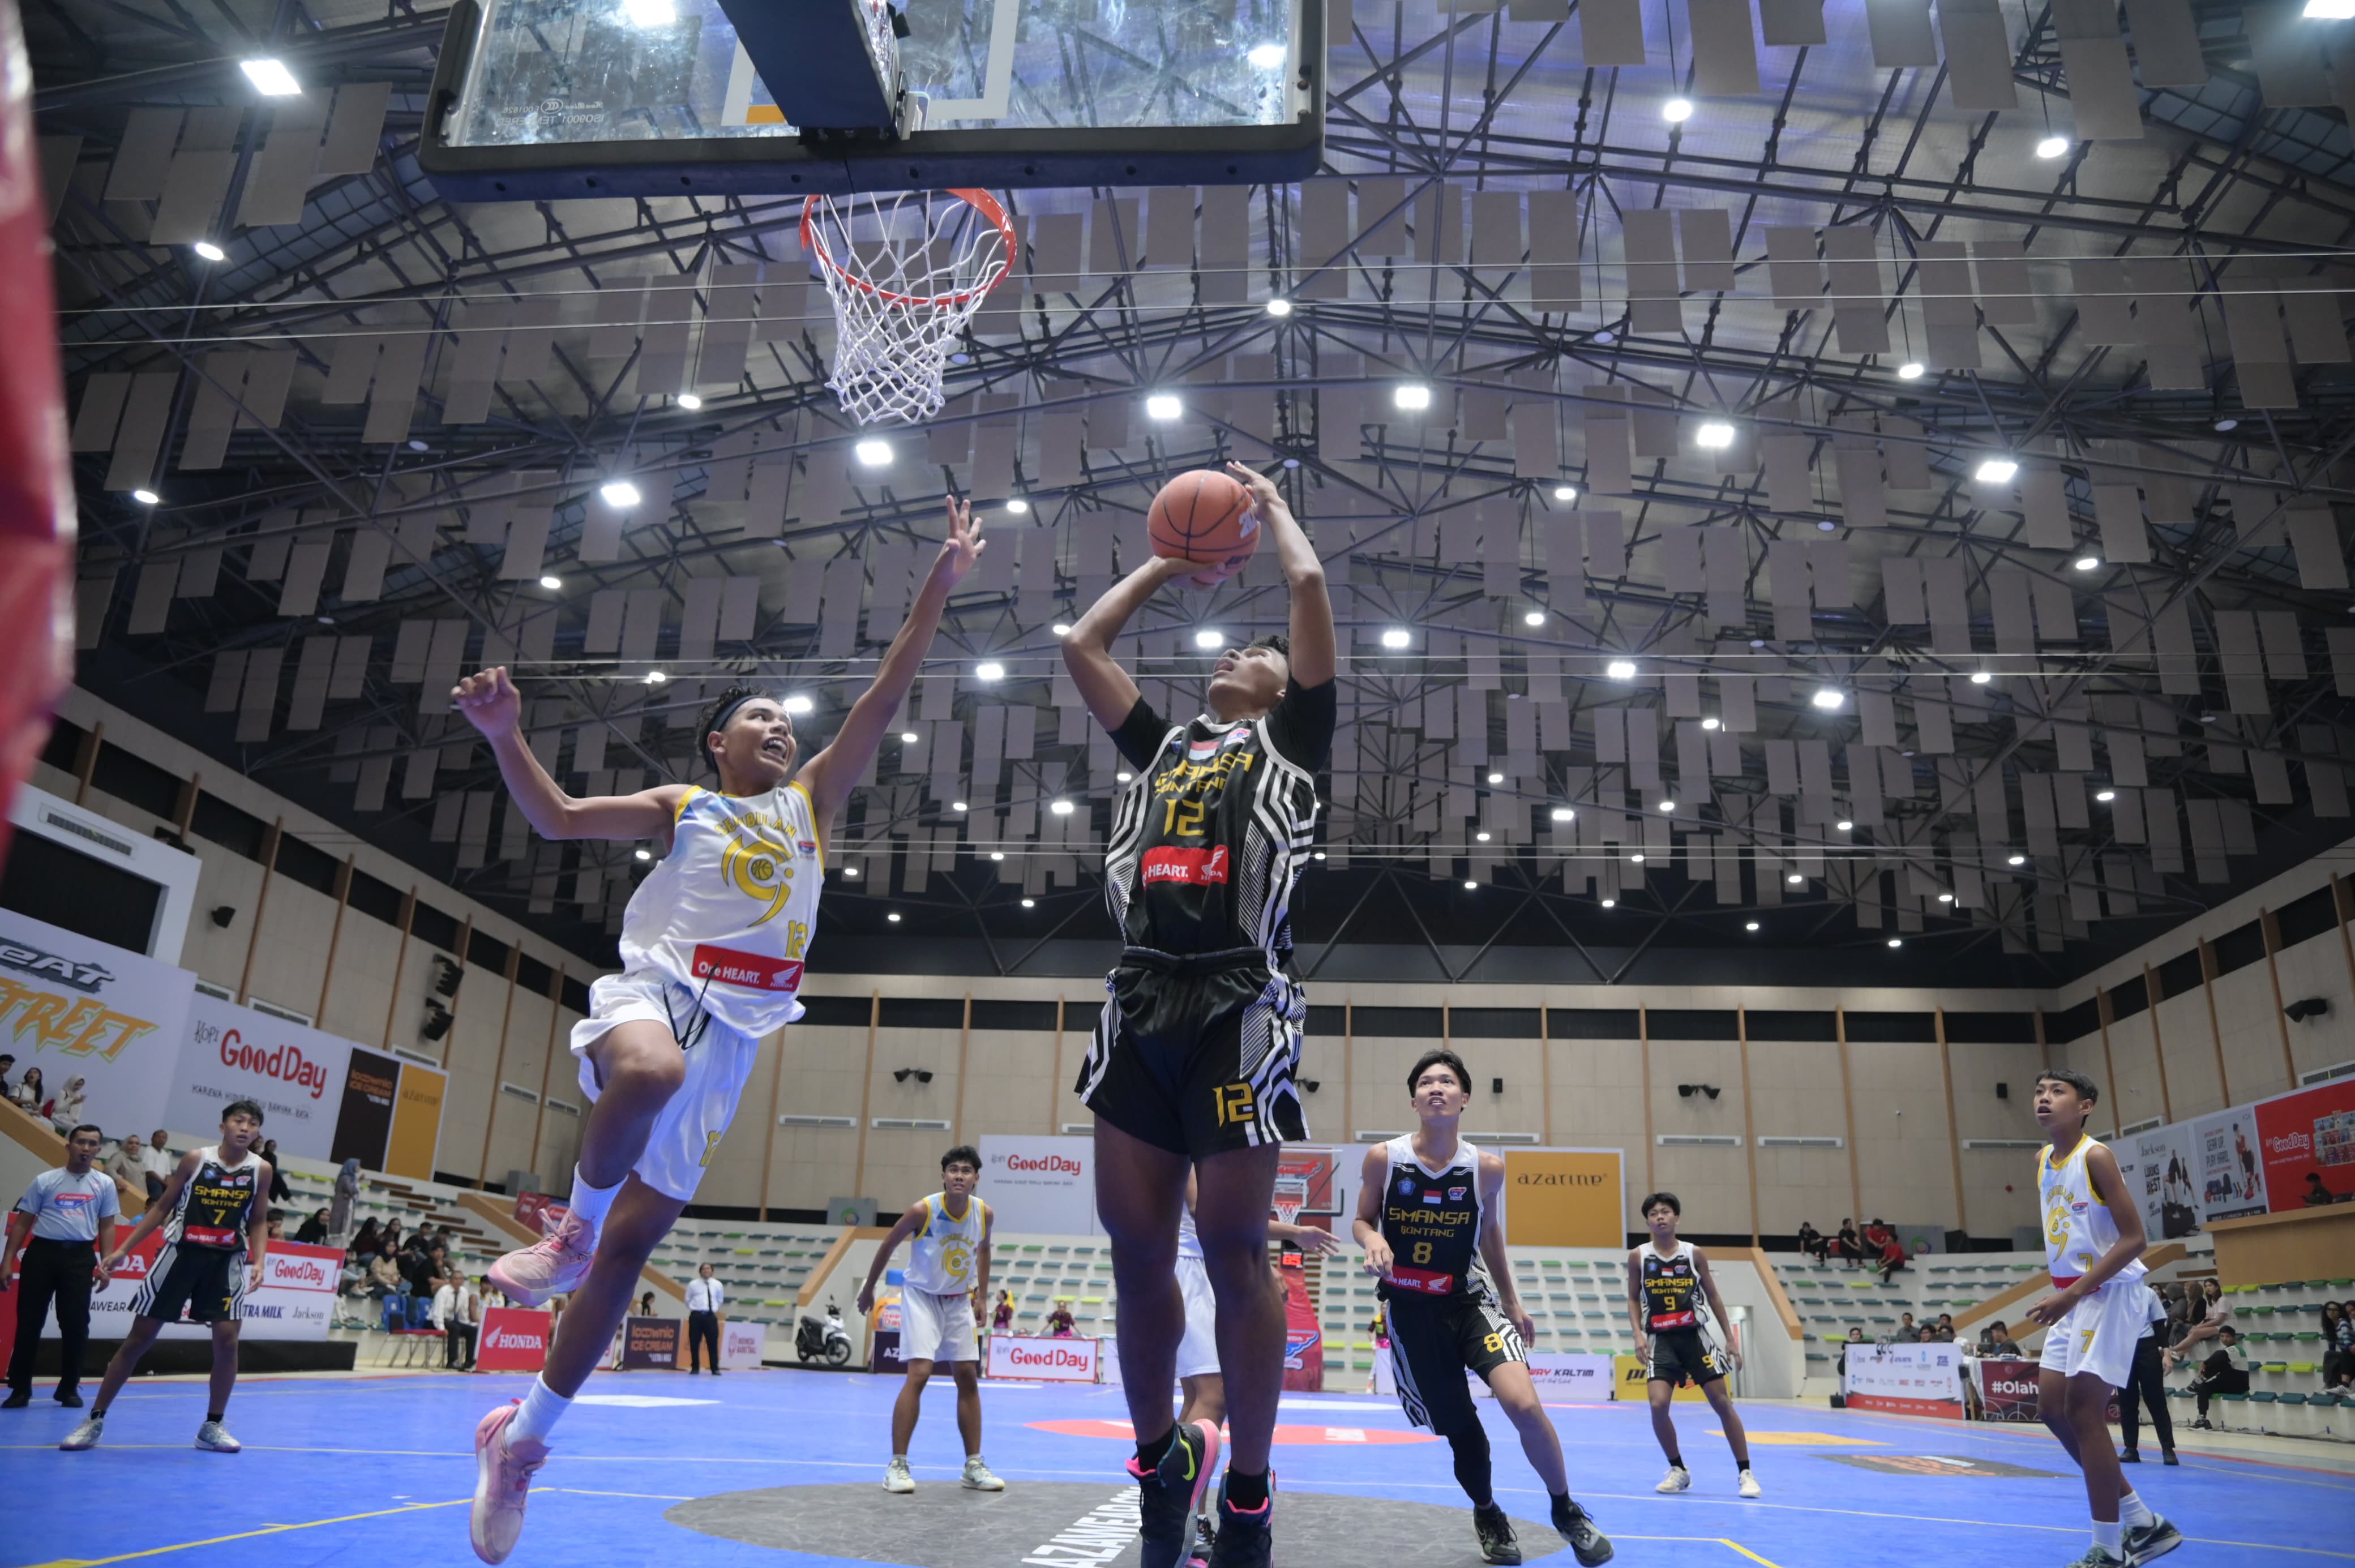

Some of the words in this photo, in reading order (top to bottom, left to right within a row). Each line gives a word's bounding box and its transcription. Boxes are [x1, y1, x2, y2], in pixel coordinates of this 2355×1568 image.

[1164, 799, 1204, 836] 12
[1148, 863, 1189, 878] HEART.
[785, 920, 808, 959] 12
[722, 966, 761, 985] HEART.
[0, 976, 161, 1063] TREET
[1212, 1082, 1254, 1128] 12
[195, 1185, 251, 1199] SMANSA
[201, 1198, 242, 1208] BONTANG
[214, 1209, 226, 1224] 7
[1389, 1207, 1471, 1225] SMANSA
[1401, 1225, 1455, 1238] BONTANG
[1412, 1241, 1433, 1264] 8
[2078, 1253, 2093, 1273] 7
[1645, 1278, 1694, 1288] SMANSA
[222, 1297, 232, 1312] 7
[1664, 1296, 1676, 1311] 9
[262, 1305, 284, 1319] MILK
[292, 1306, 325, 1319] Jackson
[498, 1334, 543, 1349] HONDA
[630, 1340, 644, 1351] ICE
[645, 1340, 674, 1352] CREAM
[1484, 1333, 1504, 1353] 8
[2082, 1330, 2095, 1353] 7
[1702, 1355, 1715, 1368] 9
[1992, 1381, 2039, 1395] #Olah
